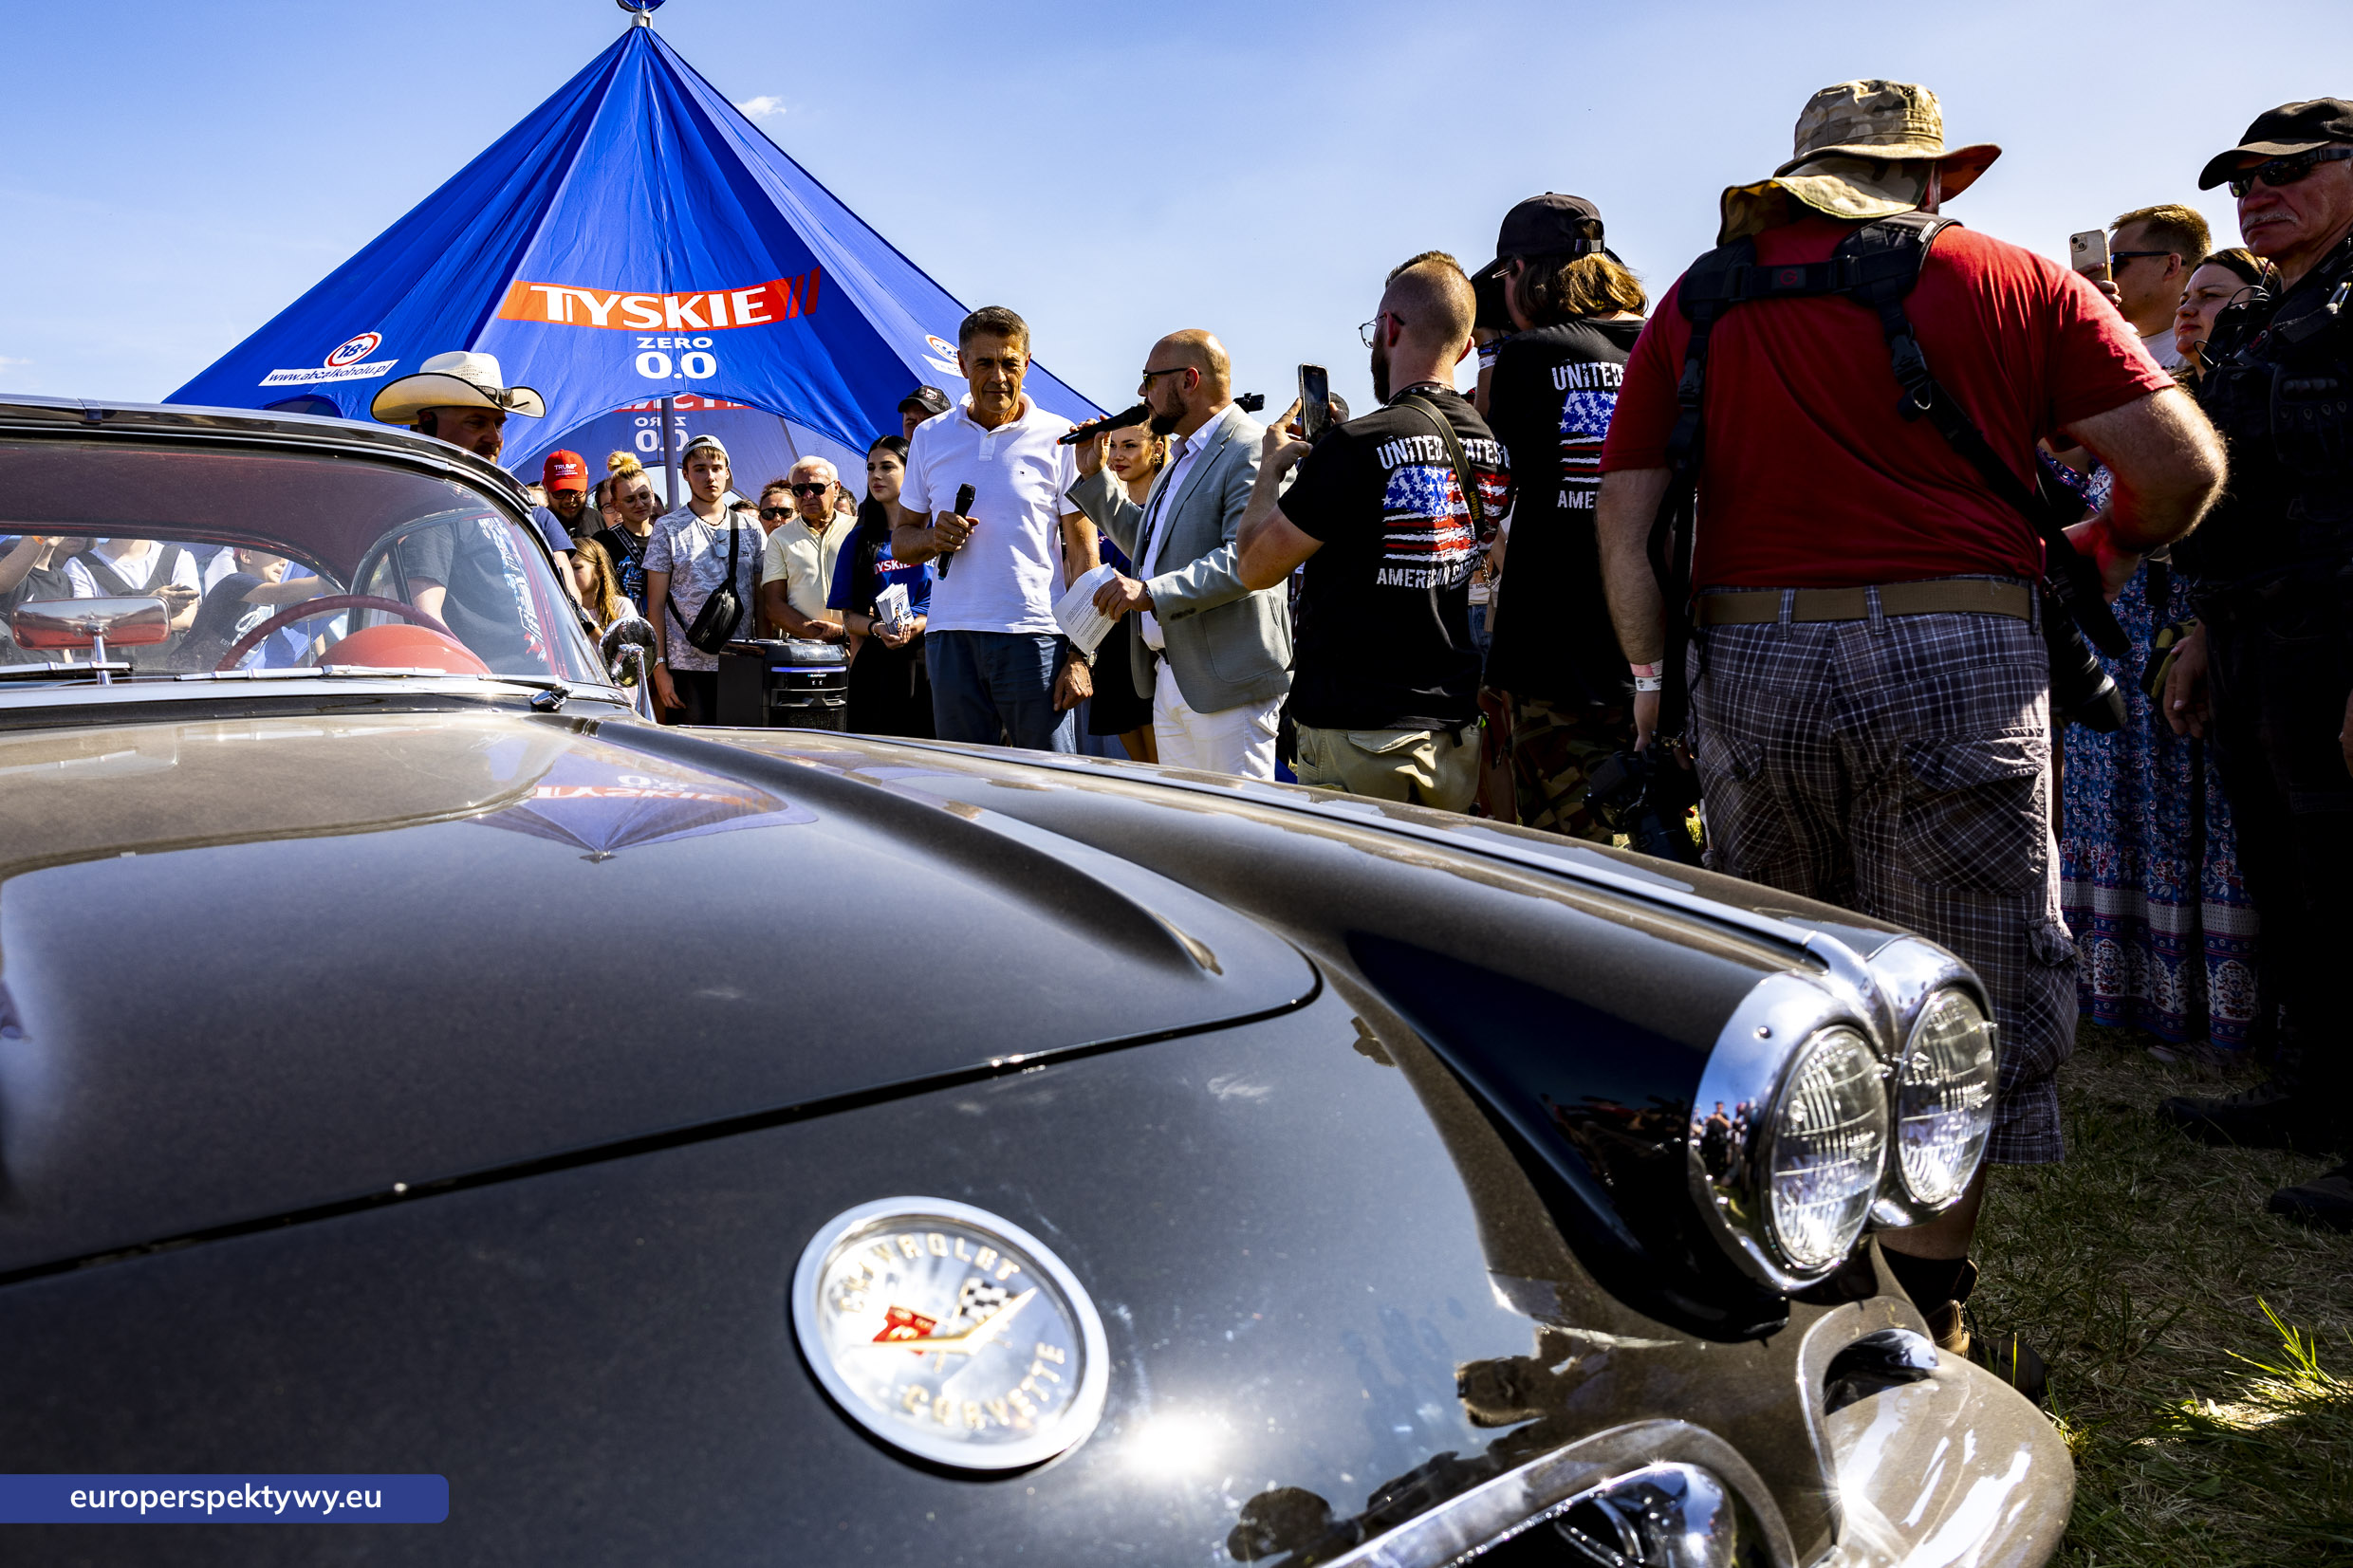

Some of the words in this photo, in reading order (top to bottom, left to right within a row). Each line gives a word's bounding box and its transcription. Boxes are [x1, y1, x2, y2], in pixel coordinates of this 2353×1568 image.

[529, 285, 772, 329] TYSKIE
[337, 343, 369, 360] 18+
[637, 336, 713, 349] ZERO
[268, 361, 393, 381] www.abcalkoholu.pl
[635, 351, 717, 379] 0.0
[1551, 361, 1623, 391] UNITED
[1376, 434, 1443, 470] UNITED
[1469, 490, 1481, 521] Nikon
[1557, 489, 1600, 509] AME
[1376, 564, 1451, 589] AMERICAN
[839, 1232, 1022, 1313] CHVROLET
[902, 1341, 1066, 1430] CORVETTE
